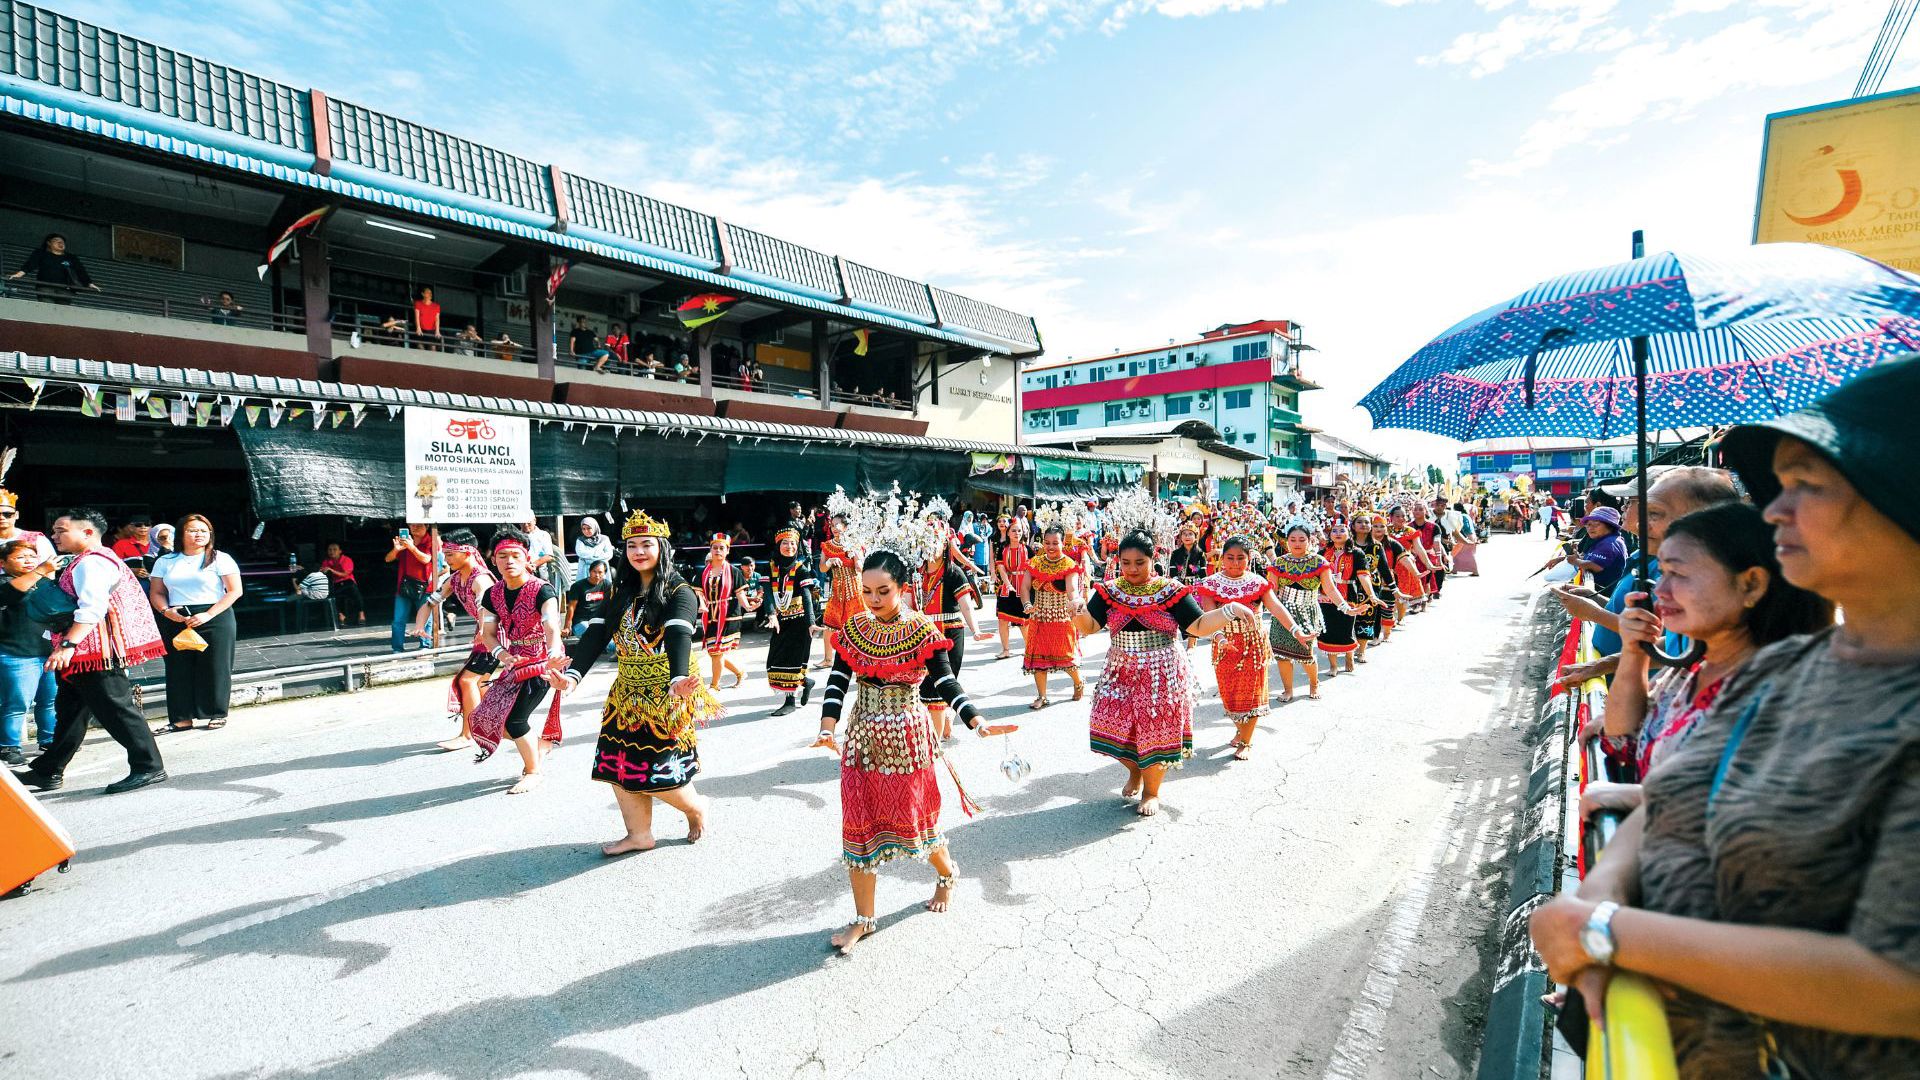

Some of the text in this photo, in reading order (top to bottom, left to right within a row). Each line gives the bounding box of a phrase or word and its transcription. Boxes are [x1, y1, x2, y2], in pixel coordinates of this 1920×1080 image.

[1806, 227, 1867, 242] SARAWAK
[431, 441, 510, 457] SILA KUNCI
[425, 454, 516, 466] MOTOSIKAL ANDA
[415, 464, 448, 472] BERSAMA
[449, 466, 497, 474] MEMBANTERAS
